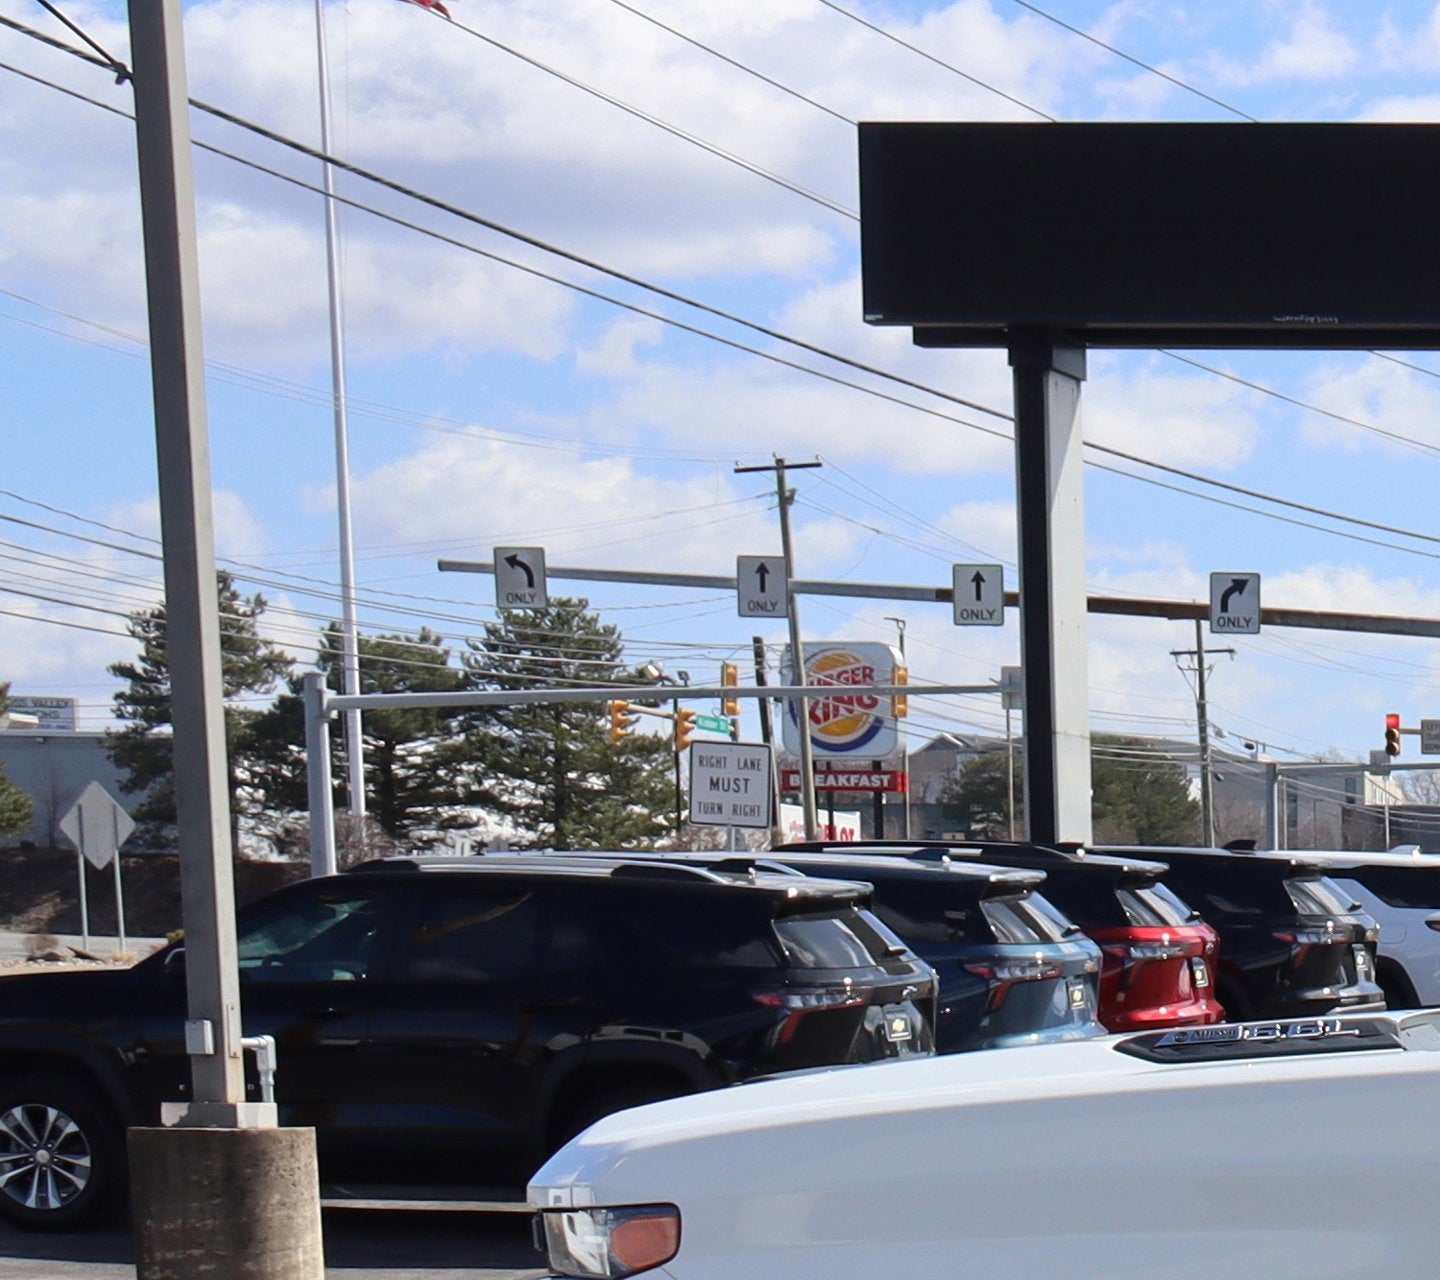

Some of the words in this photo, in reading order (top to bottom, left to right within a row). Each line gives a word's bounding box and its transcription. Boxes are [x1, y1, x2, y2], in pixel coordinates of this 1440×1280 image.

[506, 592, 537, 605] ONLY
[747, 601, 778, 613] ONLY
[960, 608, 996, 621] ONLY
[1217, 616, 1251, 628] ONLY
[699, 755, 727, 768] RIGHT
[737, 758, 762, 771] LANE
[709, 776, 750, 793] MUST
[789, 773, 891, 788] BEAKFAST
[698, 801, 723, 815] TURN
[732, 803, 761, 817] RIGHT
